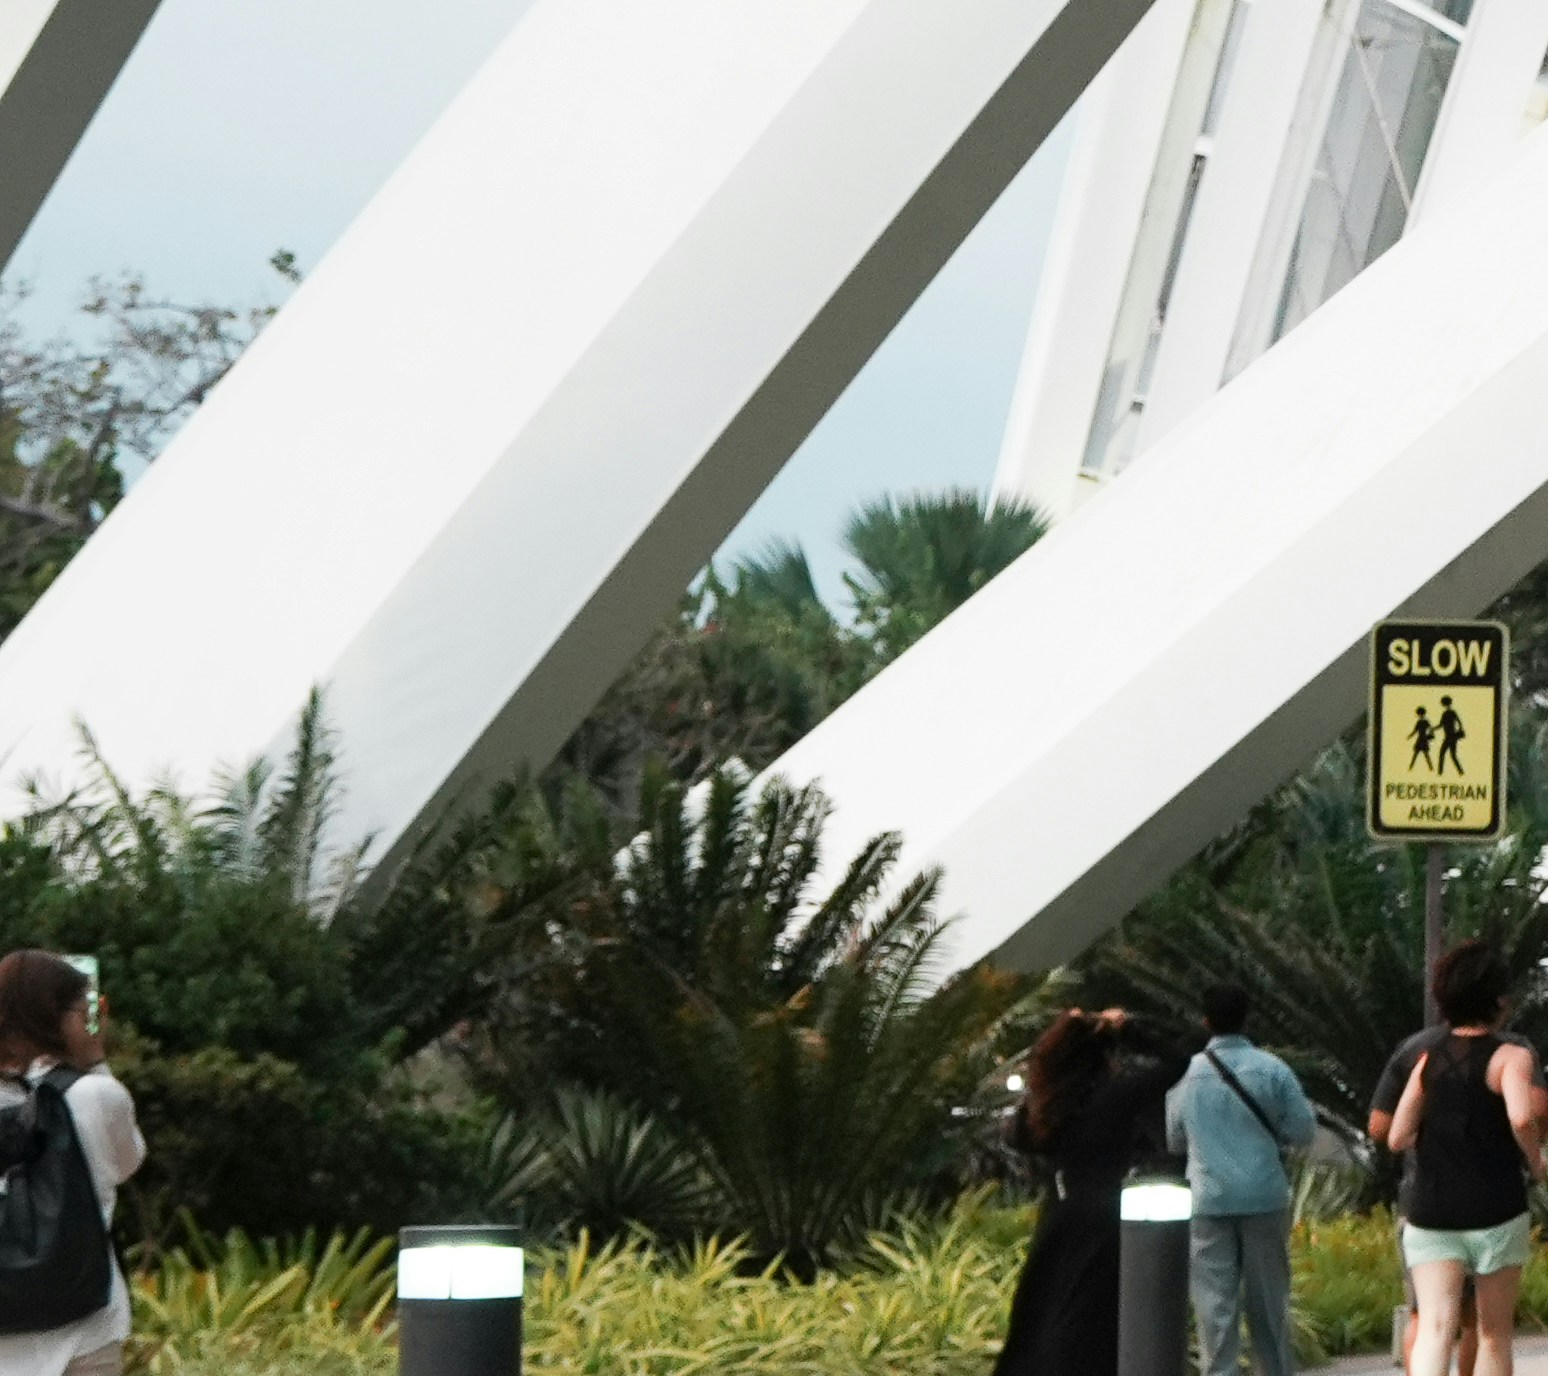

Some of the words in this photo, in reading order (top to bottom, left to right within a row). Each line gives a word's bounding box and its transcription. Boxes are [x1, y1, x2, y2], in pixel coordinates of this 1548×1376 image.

[1387, 638, 1492, 677] SLOW
[1385, 783, 1487, 801] PEDESTRIAN
[1408, 804, 1465, 822] AHEAD
